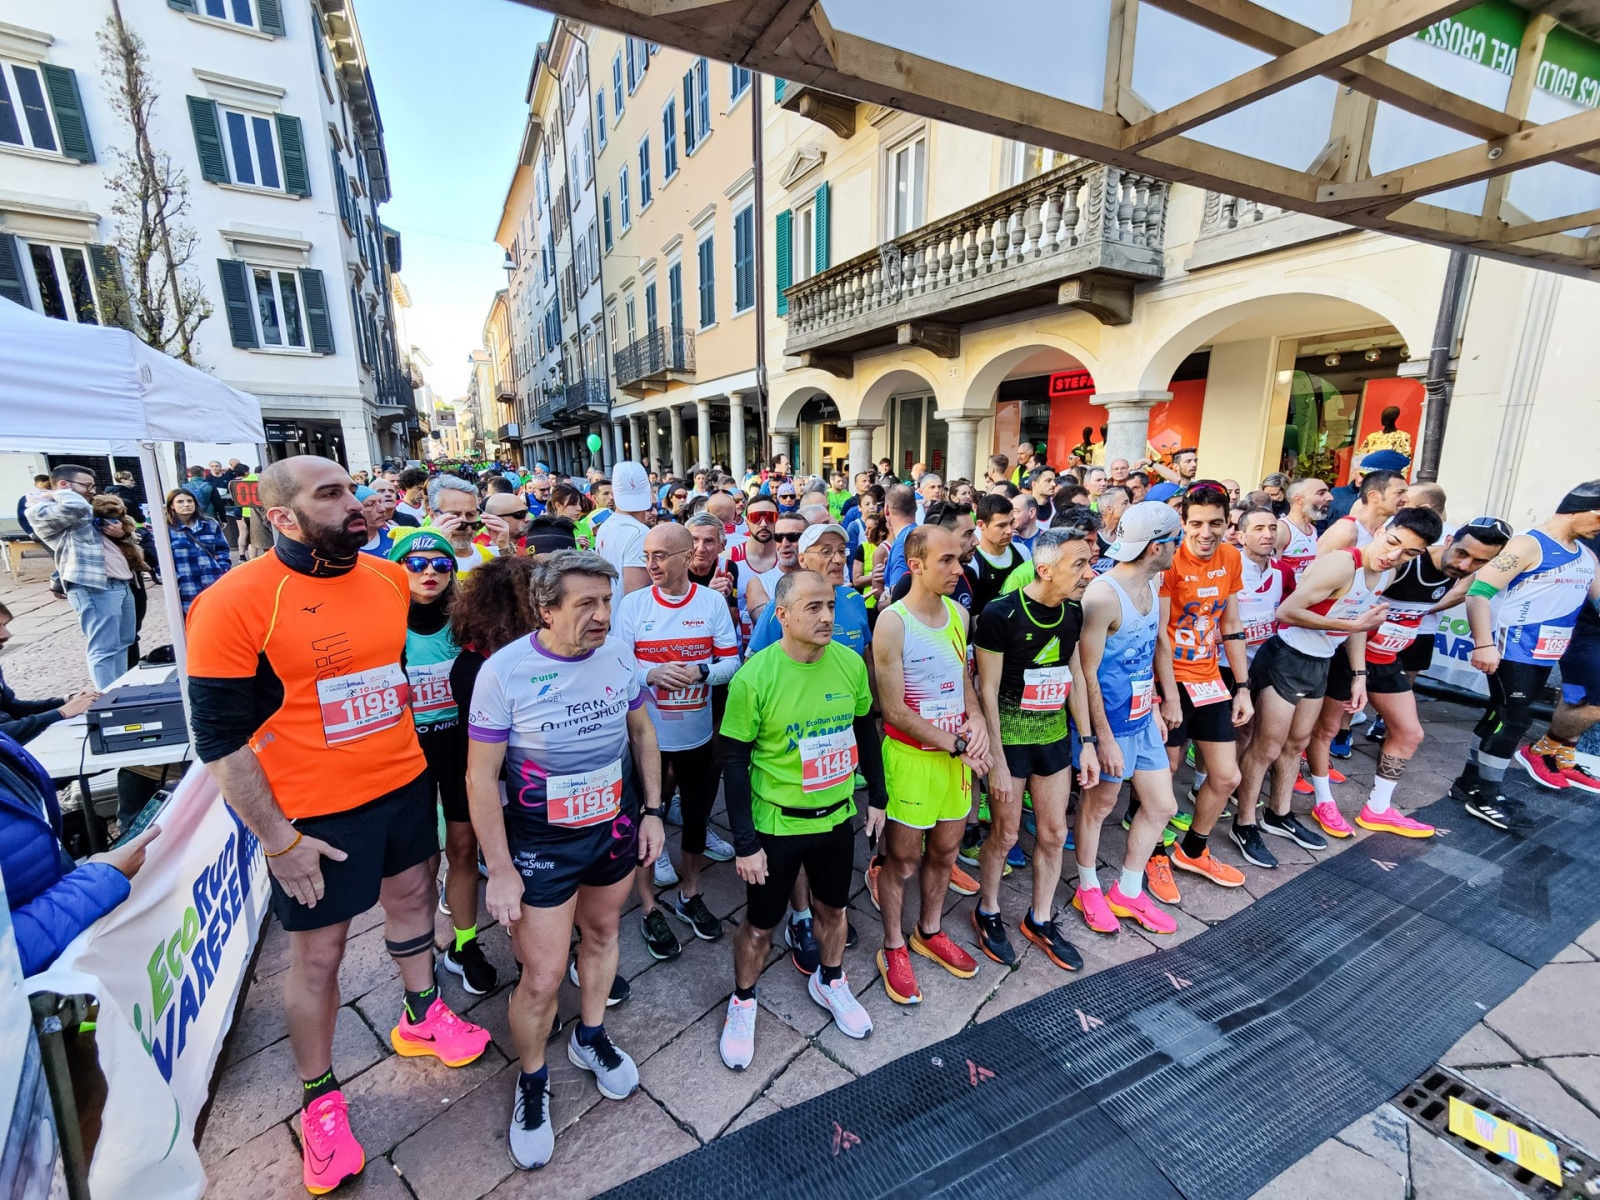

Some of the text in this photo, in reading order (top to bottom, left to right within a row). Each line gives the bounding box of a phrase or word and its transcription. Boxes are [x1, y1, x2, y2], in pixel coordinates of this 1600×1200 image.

[1425, 17, 1486, 64] CROSS
[1536, 60, 1578, 99] GOLD
[411, 536, 439, 551] BLIZZ
[1206, 565, 1227, 579] enel
[669, 643, 706, 652] Varese
[538, 672, 559, 682] UISP
[1035, 683, 1067, 701] 1132
[1190, 680, 1222, 697] 1064
[341, 688, 399, 722] 1198
[565, 699, 608, 717] TEAM
[577, 722, 602, 736] ASD
[805, 717, 831, 728] EcoRun
[814, 749, 852, 778] 1148
[562, 786, 615, 818] 1196
[152, 866, 242, 1085] VARESE
